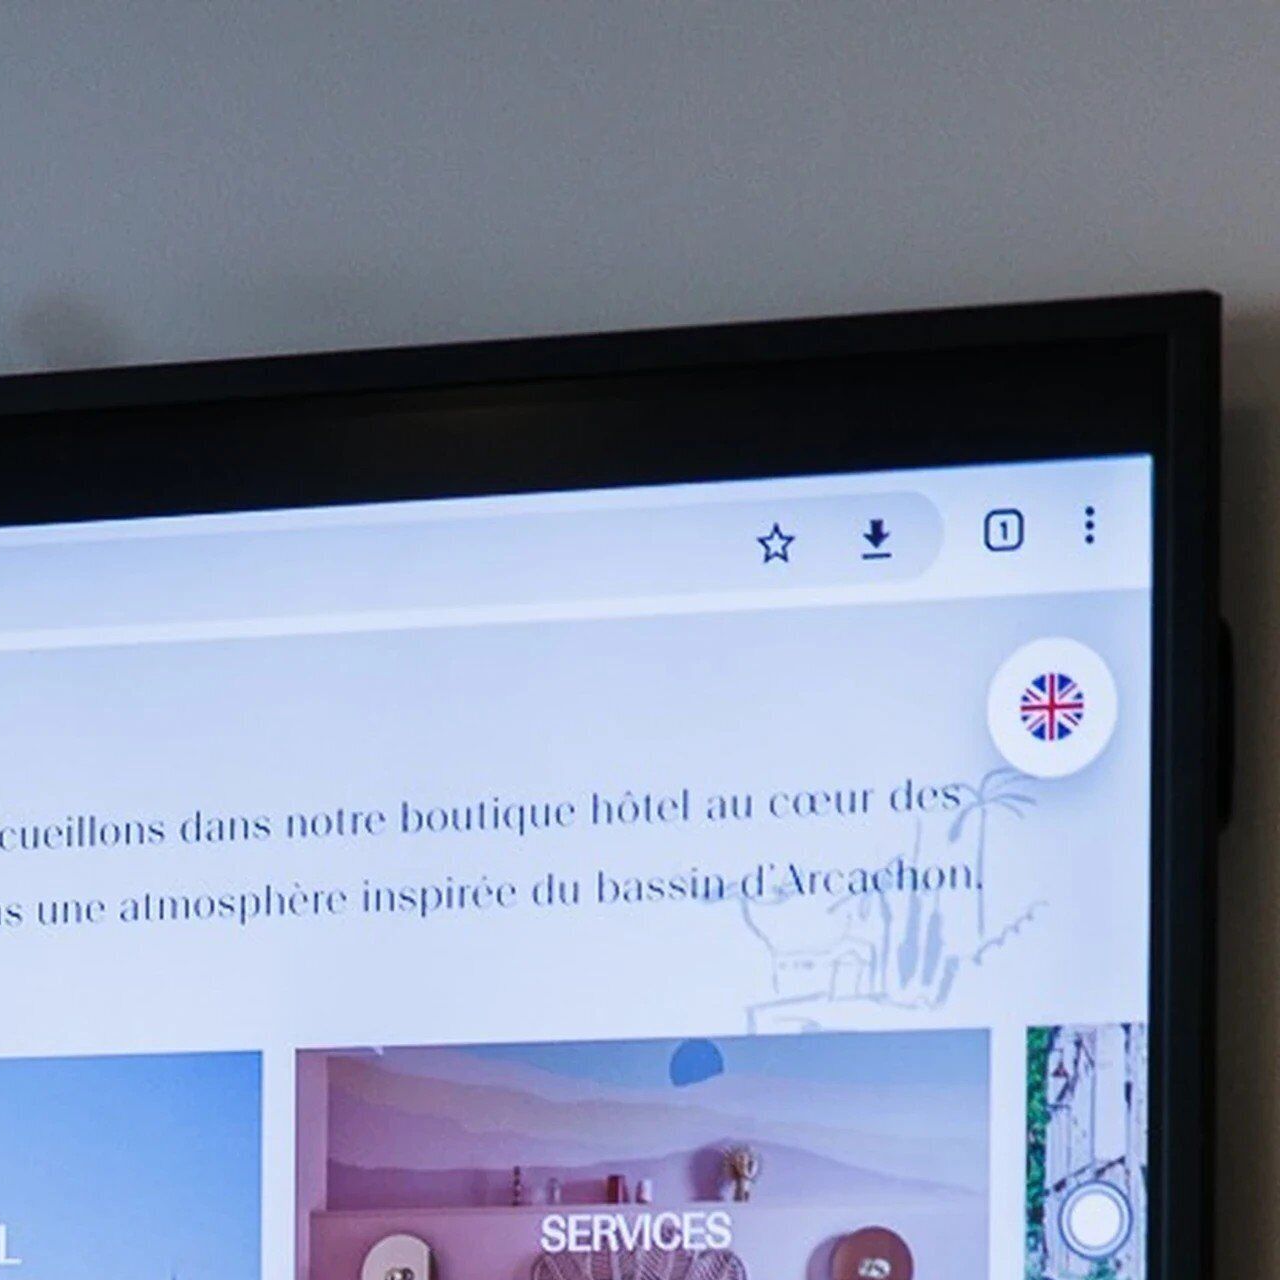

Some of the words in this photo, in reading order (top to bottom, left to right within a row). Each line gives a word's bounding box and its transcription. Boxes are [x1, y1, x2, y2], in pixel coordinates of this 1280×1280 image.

[178, 809, 272, 845] dans
[285, 808, 388, 838] notre
[400, 796, 577, 838] boutique
[591, 787, 690, 825] hôtel
[705, 792, 754, 822] au
[767, 788, 876, 818] cœur
[888, 778, 962, 810] des
[37, 898, 107, 926] une
[119, 881, 348, 925] atmosphère
[360, 876, 517, 916] inspirée
[532, 870, 581, 904] du
[596, 869, 725, 902] bassin
[540, 1211, 732, 1253] SERVICES
